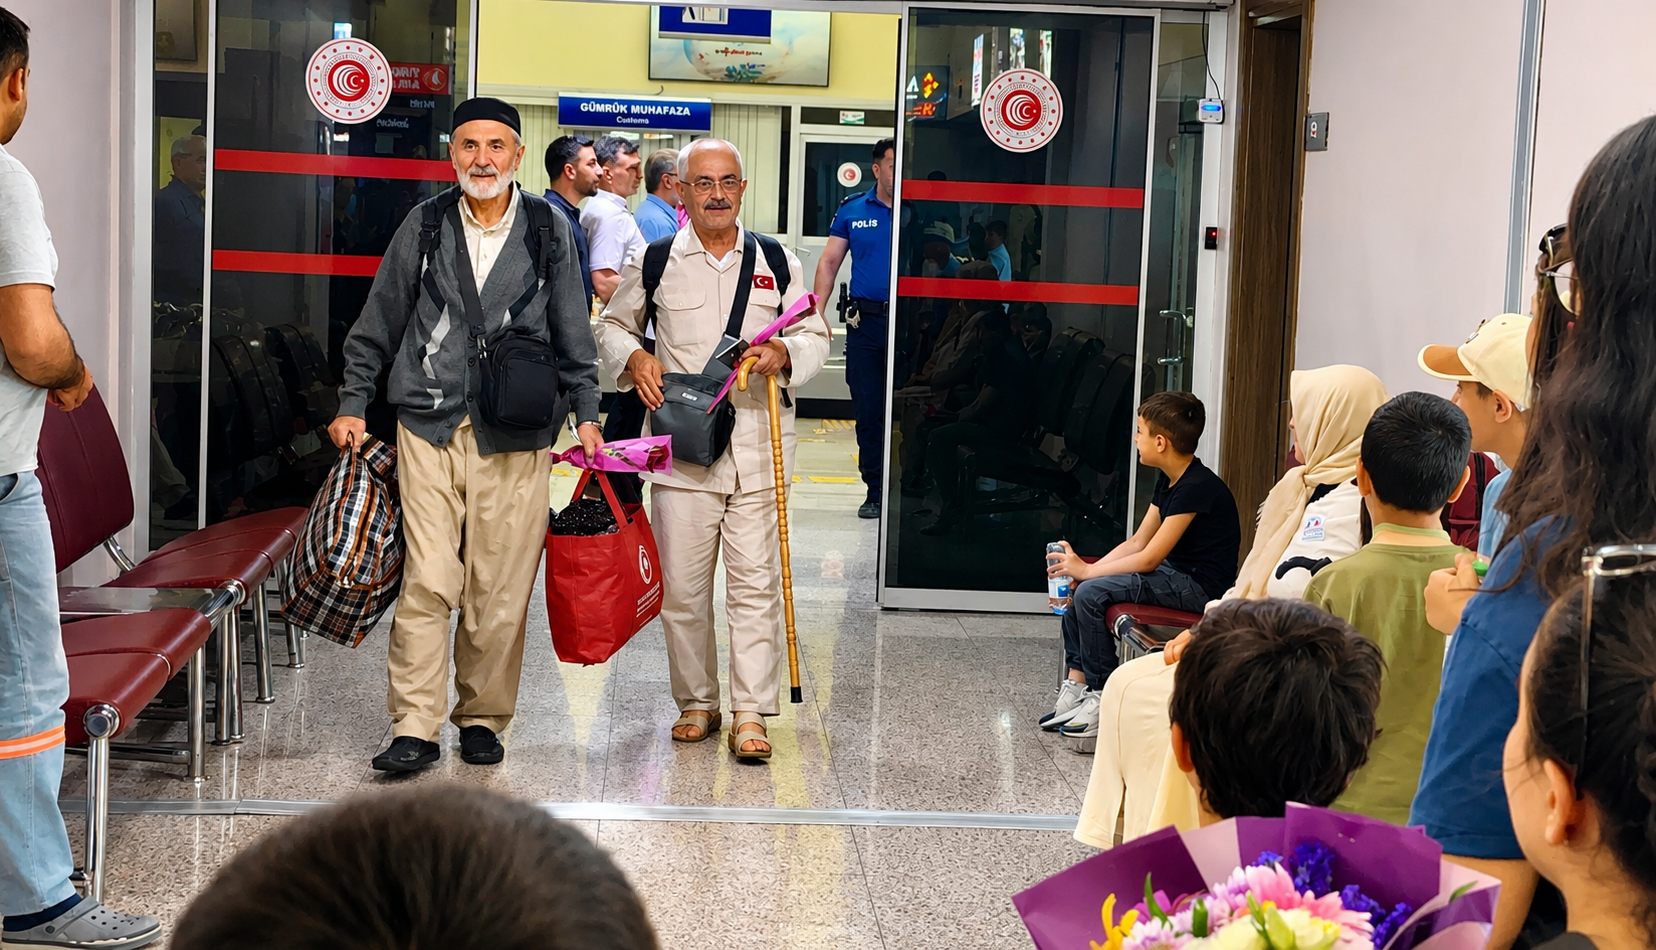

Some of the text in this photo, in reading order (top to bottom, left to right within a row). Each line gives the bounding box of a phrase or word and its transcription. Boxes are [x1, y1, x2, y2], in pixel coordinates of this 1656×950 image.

[580, 101, 691, 116] GÜMRÜK MUHAFAZA
[616, 116, 650, 125] Customs
